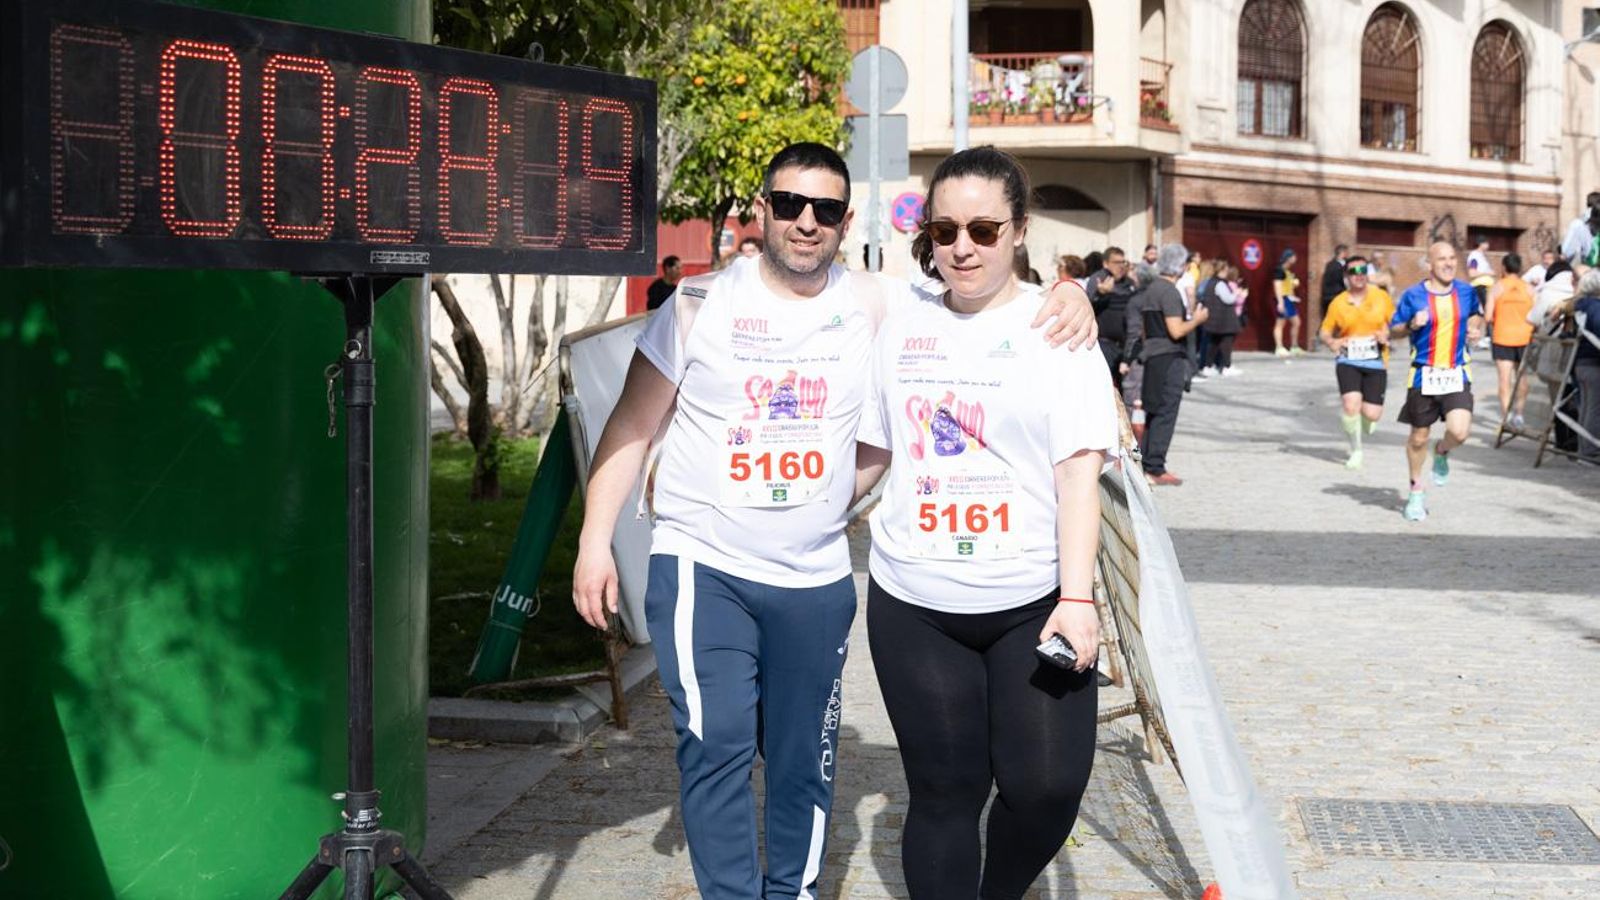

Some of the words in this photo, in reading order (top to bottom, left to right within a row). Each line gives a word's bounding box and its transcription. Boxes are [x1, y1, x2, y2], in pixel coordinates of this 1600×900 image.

[159, 39, 633, 251] 00:28:19
[732, 317, 768, 334] XXVII
[902, 336, 938, 351] XXVII
[729, 451, 825, 482] 5160
[918, 502, 1009, 533] 5161
